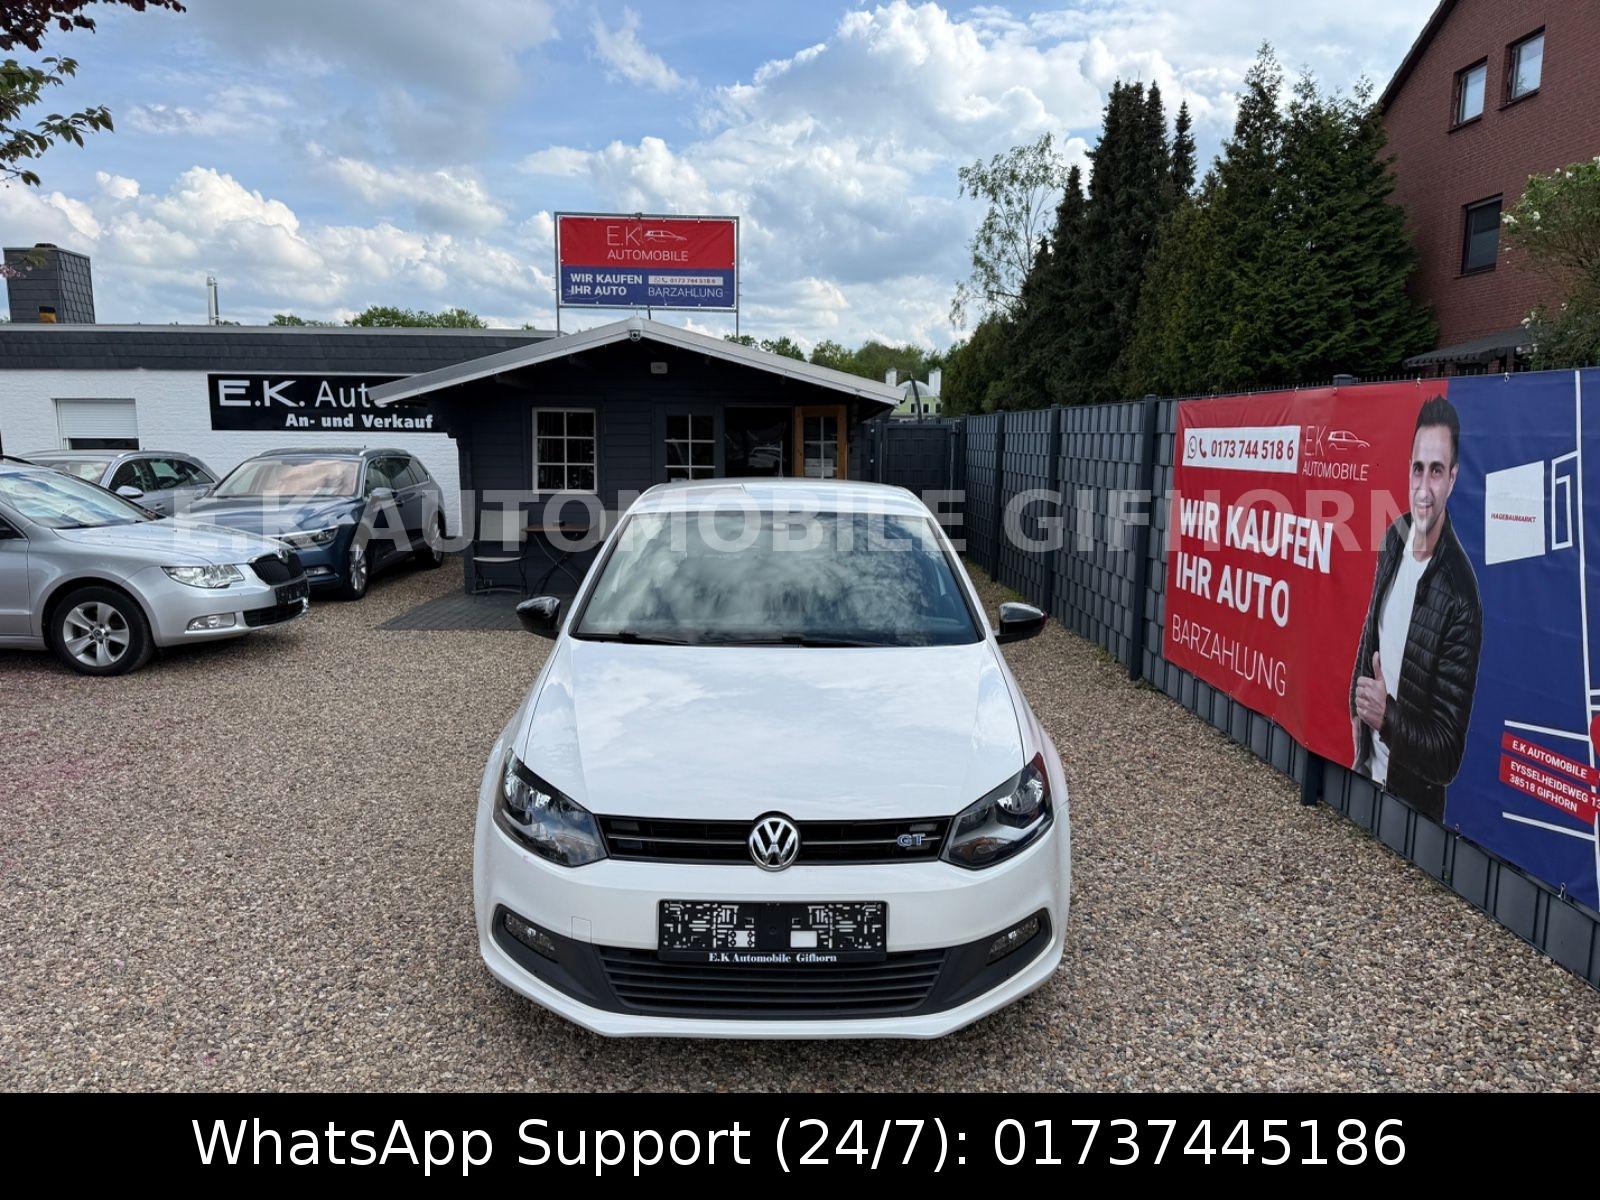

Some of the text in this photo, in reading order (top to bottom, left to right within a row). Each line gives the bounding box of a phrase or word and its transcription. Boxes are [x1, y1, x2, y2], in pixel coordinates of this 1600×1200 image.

[607, 250, 689, 262] AUTOMOBILE
[570, 273, 643, 285] WIR KAUFEN
[571, 286, 627, 296] IHR AUTO
[648, 287, 724, 298] BARZAHLUNG
[218, 379, 306, 408] E.K.
[285, 414, 433, 429] An- und Verkauf
[1211, 440, 1236, 458] 0173
[1238, 440, 1259, 459] 744
[1302, 461, 1369, 481] AUTOMOBILE
[1490, 512, 1537, 523] HAGEBAUMARKT
[1180, 498, 1334, 574] WIR KAUFEN
[1176, 551, 1290, 628] IHR AUTO
[1172, 614, 1287, 697] BARZAHLUNG
[1511, 739, 1588, 779] E.K AUTOMOBILE
[1510, 761, 1589, 803] EYSSELHEIDEWEG
[1508, 773, 1578, 813] 38518 GIFHORN
[897, 833, 926, 848] GT
[708, 952, 837, 964] E.K Automobile Gifhorn
